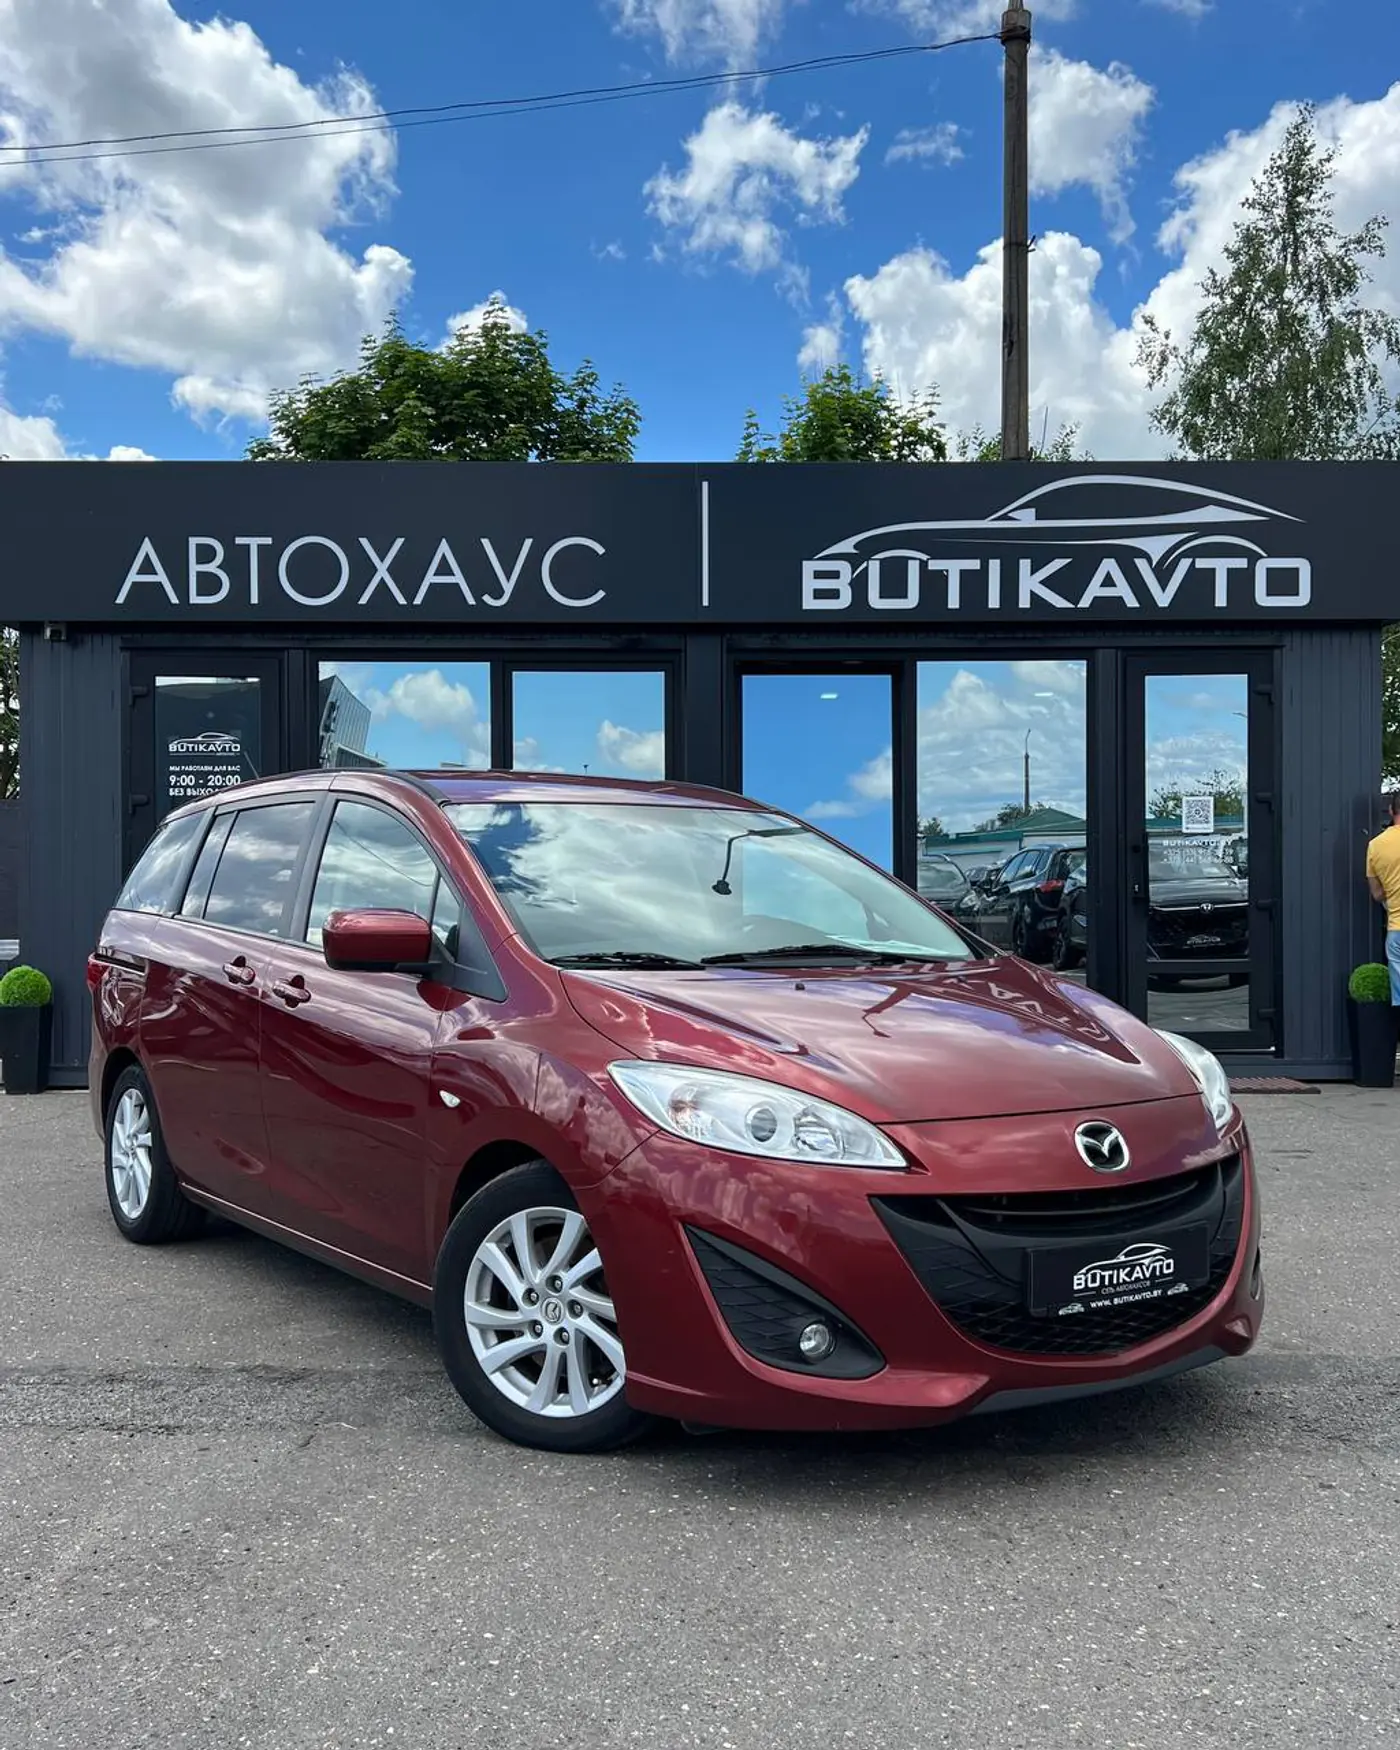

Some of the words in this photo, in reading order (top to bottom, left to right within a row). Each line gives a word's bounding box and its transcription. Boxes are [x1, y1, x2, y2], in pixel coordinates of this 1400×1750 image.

[116, 536, 605, 606] АВТОХАУС
[803, 556, 1310, 609] BUTIKAVTO
[169, 744, 241, 752] BUTIKAVTO
[169, 775, 195, 786] 9:00
[207, 775, 241, 786] 20:00
[169, 788, 184, 796] БЕЗ
[1073, 1259, 1175, 1290] BUTIKAVTO
[1113, 1289, 1163, 1305] BUTIKAVTO.BY
